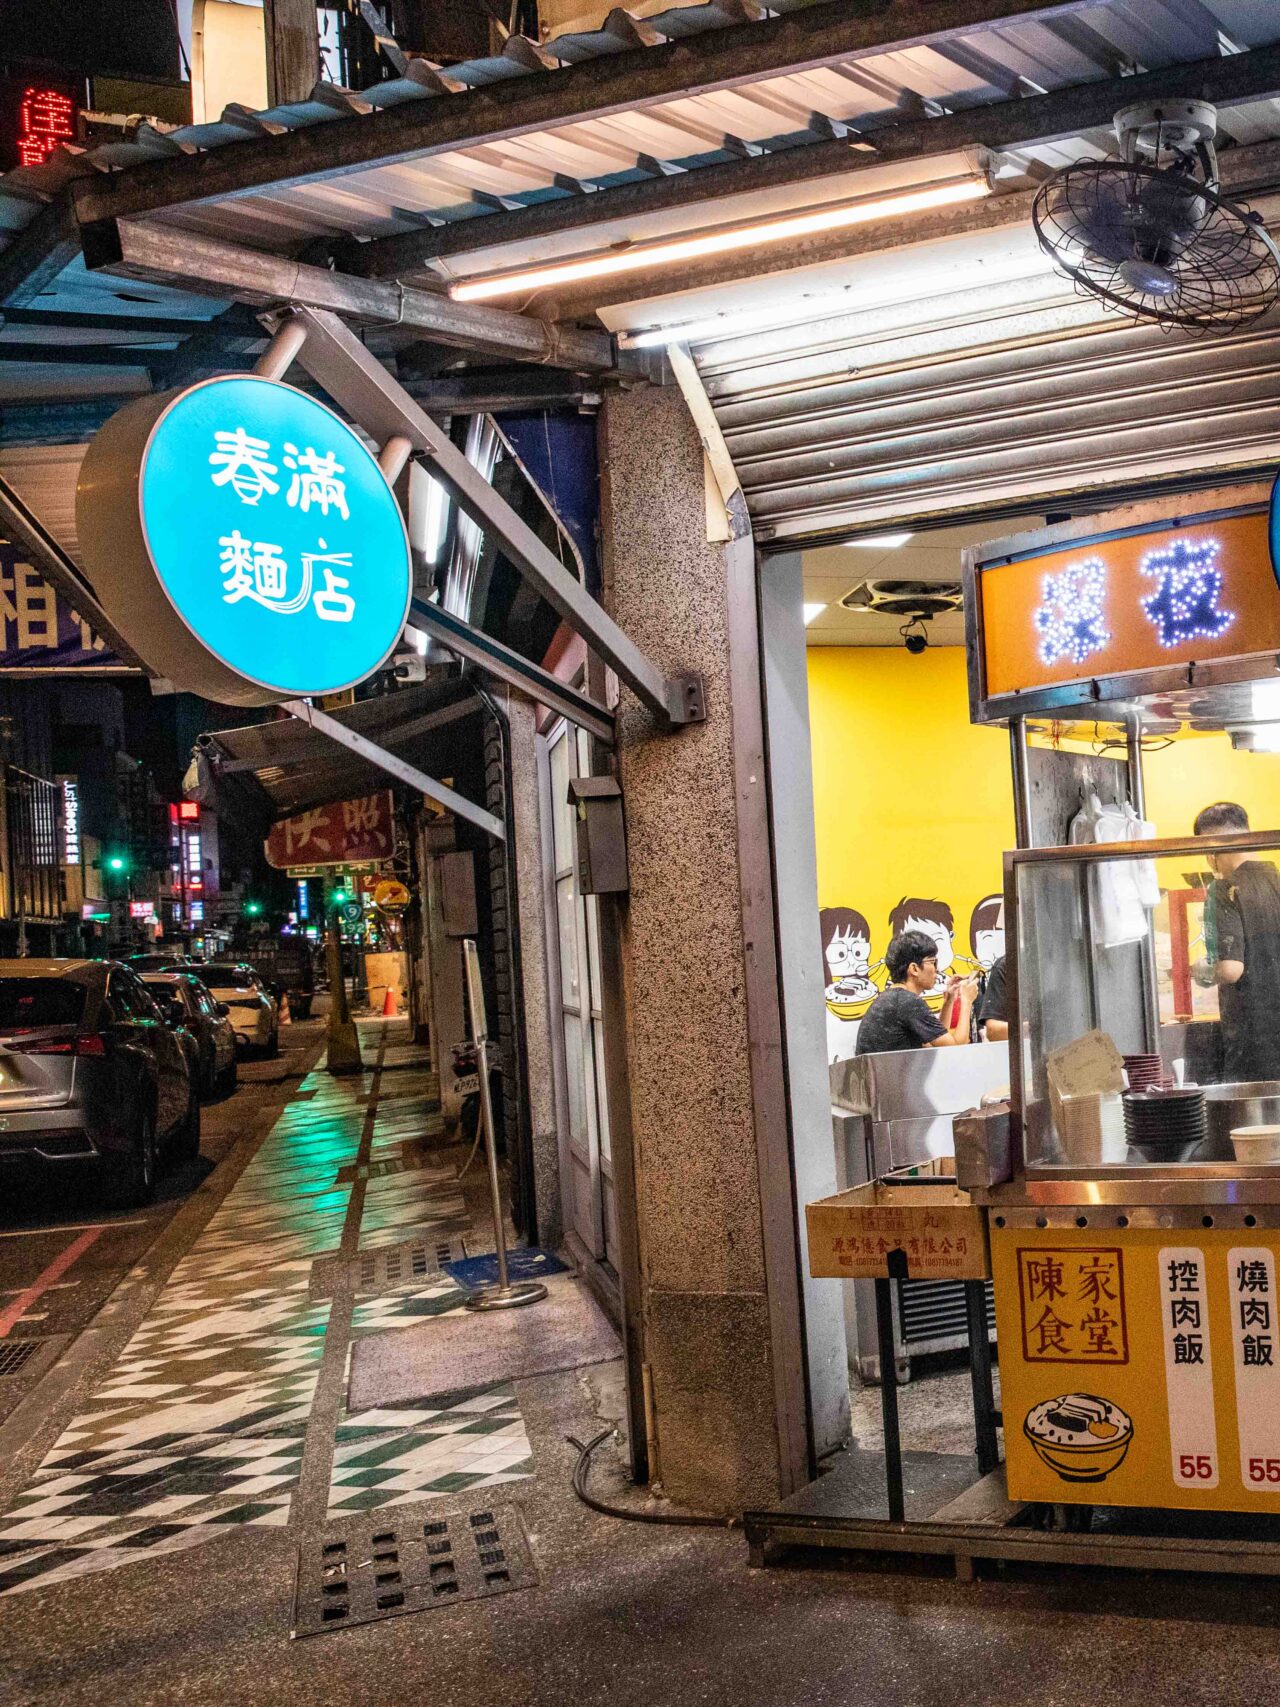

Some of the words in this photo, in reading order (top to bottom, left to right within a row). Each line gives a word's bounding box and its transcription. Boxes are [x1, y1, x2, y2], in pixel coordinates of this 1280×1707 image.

[208, 427, 350, 520] 春滿
[218, 529, 356, 622] 麵店
[1026, 1256, 1118, 1305] 陳家
[1167, 1261, 1204, 1365] 控肉飯
[1236, 1261, 1274, 1366] 燒肉飯
[1028, 1304, 1119, 1355] 食堂
[1180, 1456, 1213, 1480] 55
